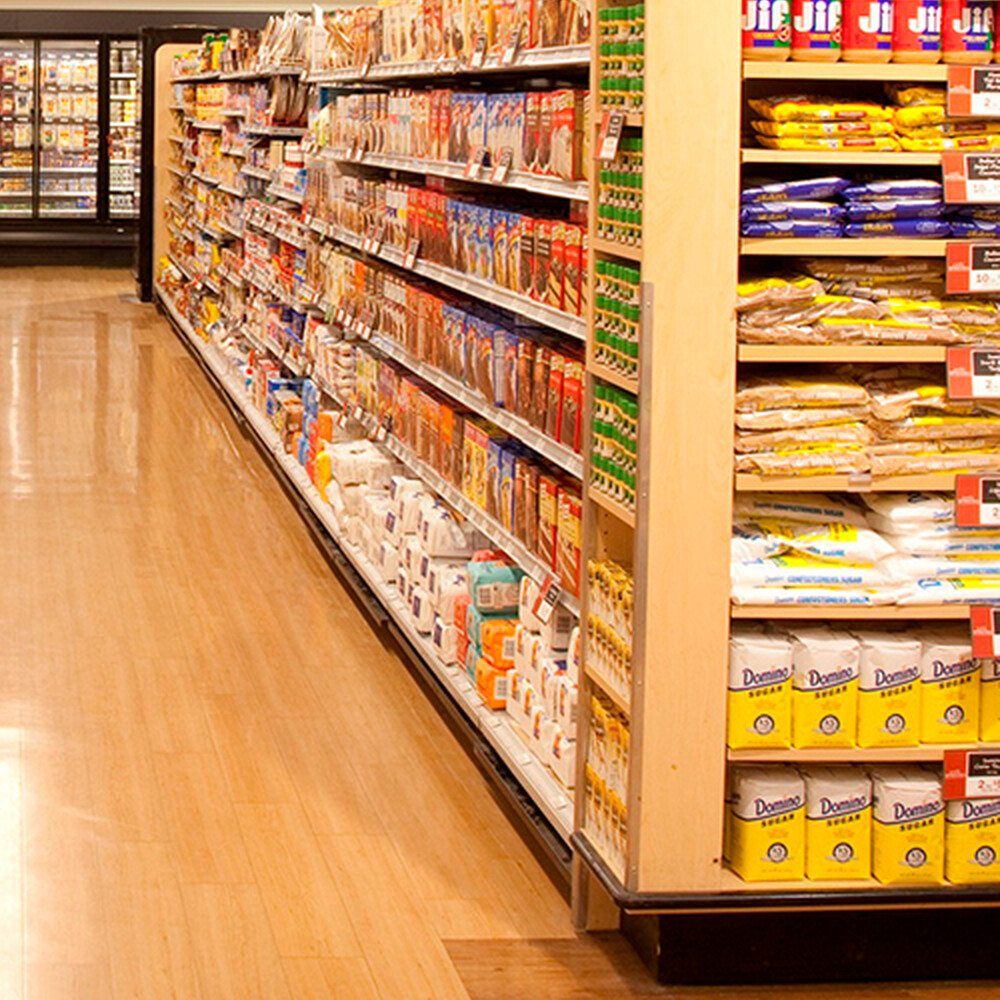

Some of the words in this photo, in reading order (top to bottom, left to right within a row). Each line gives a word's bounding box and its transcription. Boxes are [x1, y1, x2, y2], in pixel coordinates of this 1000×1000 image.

[793, 0, 842, 32] Jif
[858, 1, 894, 34] Ji
[742, 666, 788, 686] Domino
[808, 666, 853, 686] Domino
[874, 665, 918, 686] Domino
[932, 656, 978, 677] Domino
[748, 686, 782, 698] SUGAR
[880, 684, 912, 698] SUGAR
[939, 676, 972, 689] SUGAR
[815, 686, 847, 699] SUGAR
[754, 795, 800, 816] Domino
[820, 796, 866, 815] Domino
[893, 800, 940, 820] Domino
[761, 814, 794, 828] SUGAR
[827, 814, 860, 827] SUGAR
[900, 818, 934, 832] SUGAR
